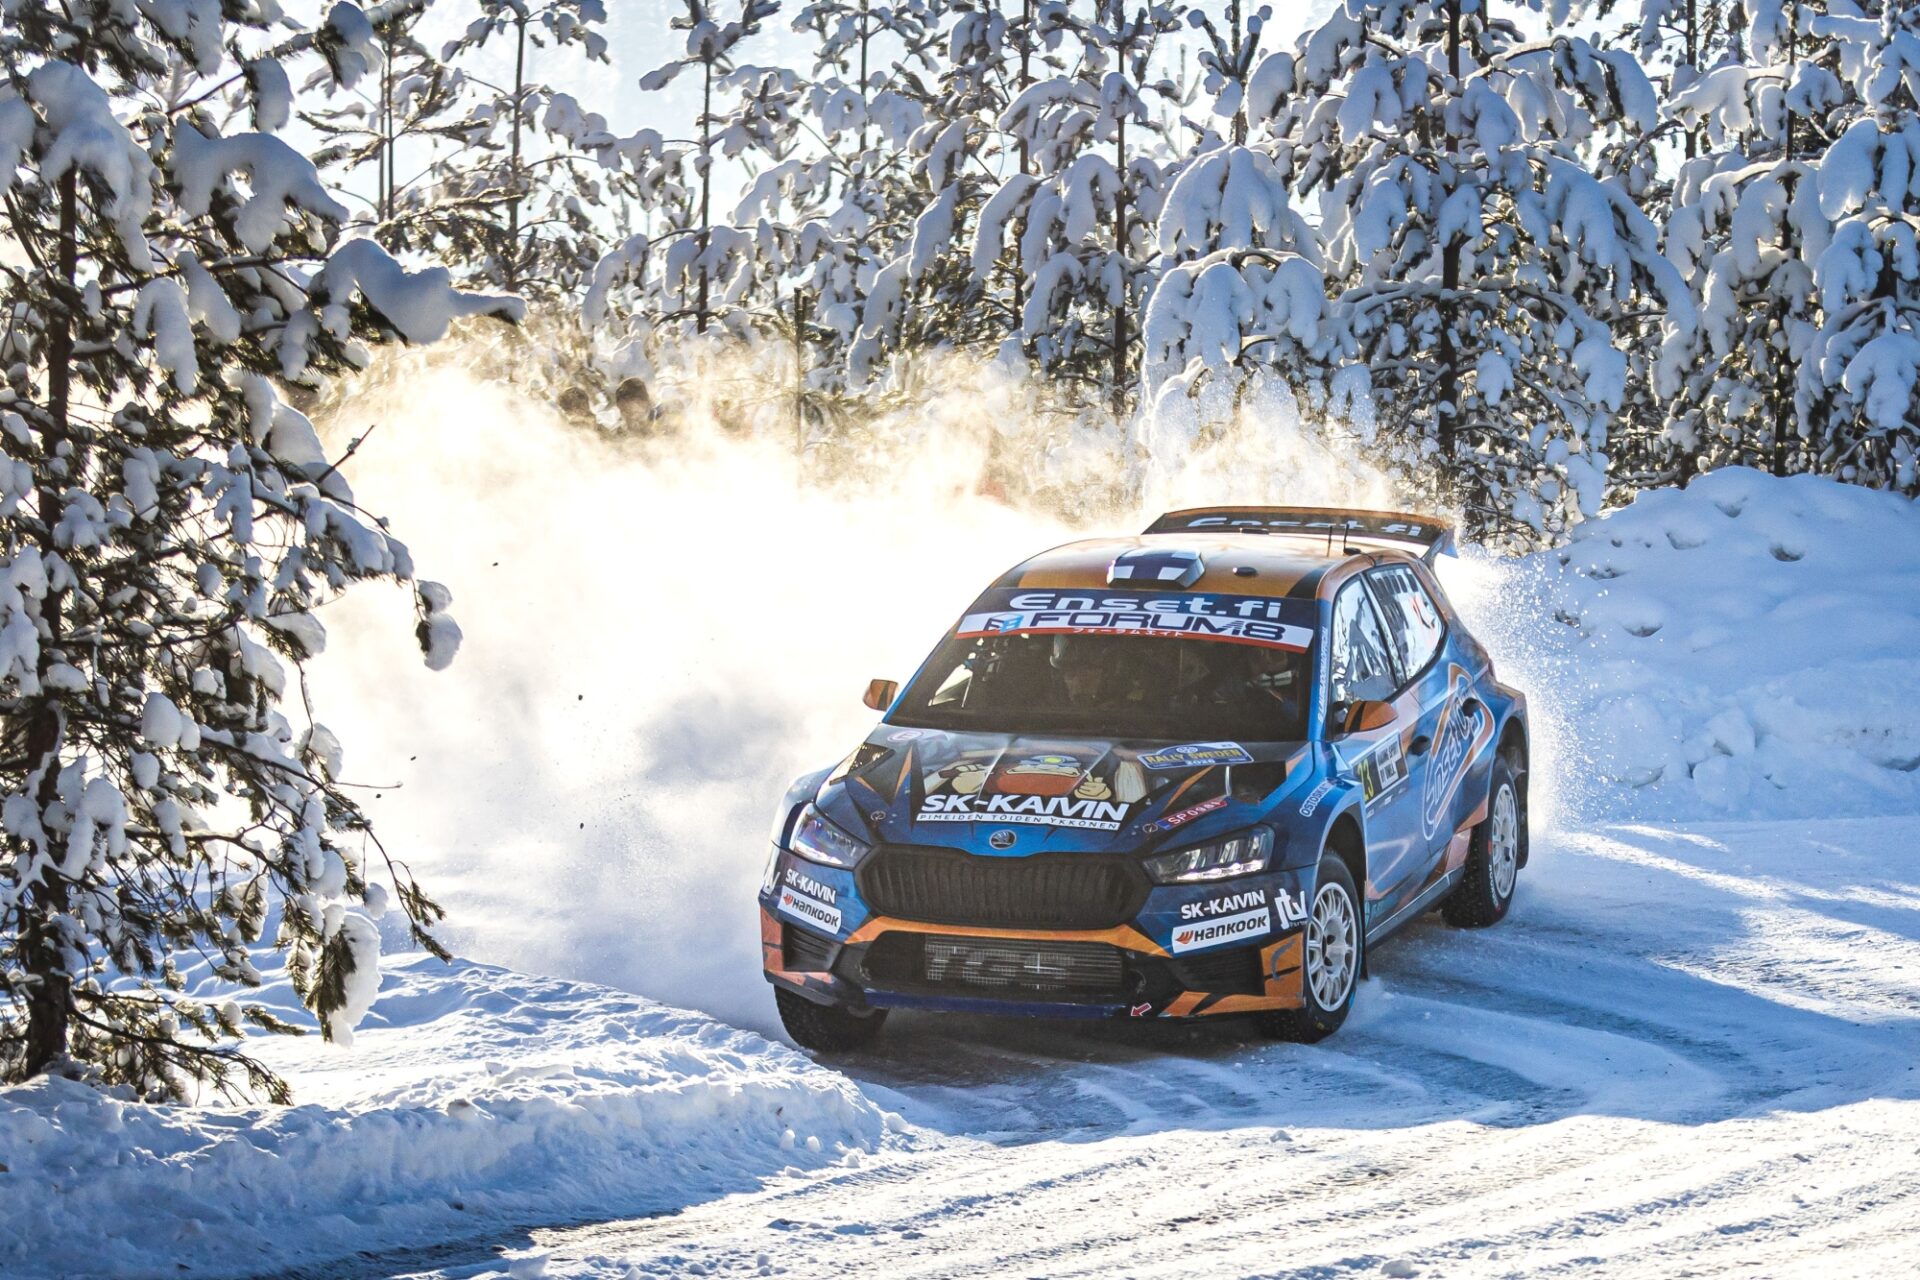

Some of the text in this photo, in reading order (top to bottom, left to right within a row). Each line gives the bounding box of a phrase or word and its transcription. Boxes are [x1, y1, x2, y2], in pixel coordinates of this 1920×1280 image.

[1009, 593, 1281, 619] Enset.fi
[1029, 611, 1286, 641] FORUM8
[1145, 748, 1242, 763] RALLY SWEDEN
[919, 813, 984, 821] PIMEIDEN
[921, 794, 1130, 821] SK-KAIVIN
[785, 868, 837, 904] SK-KAIVIN
[1181, 889, 1265, 919] SK-KAIVIN
